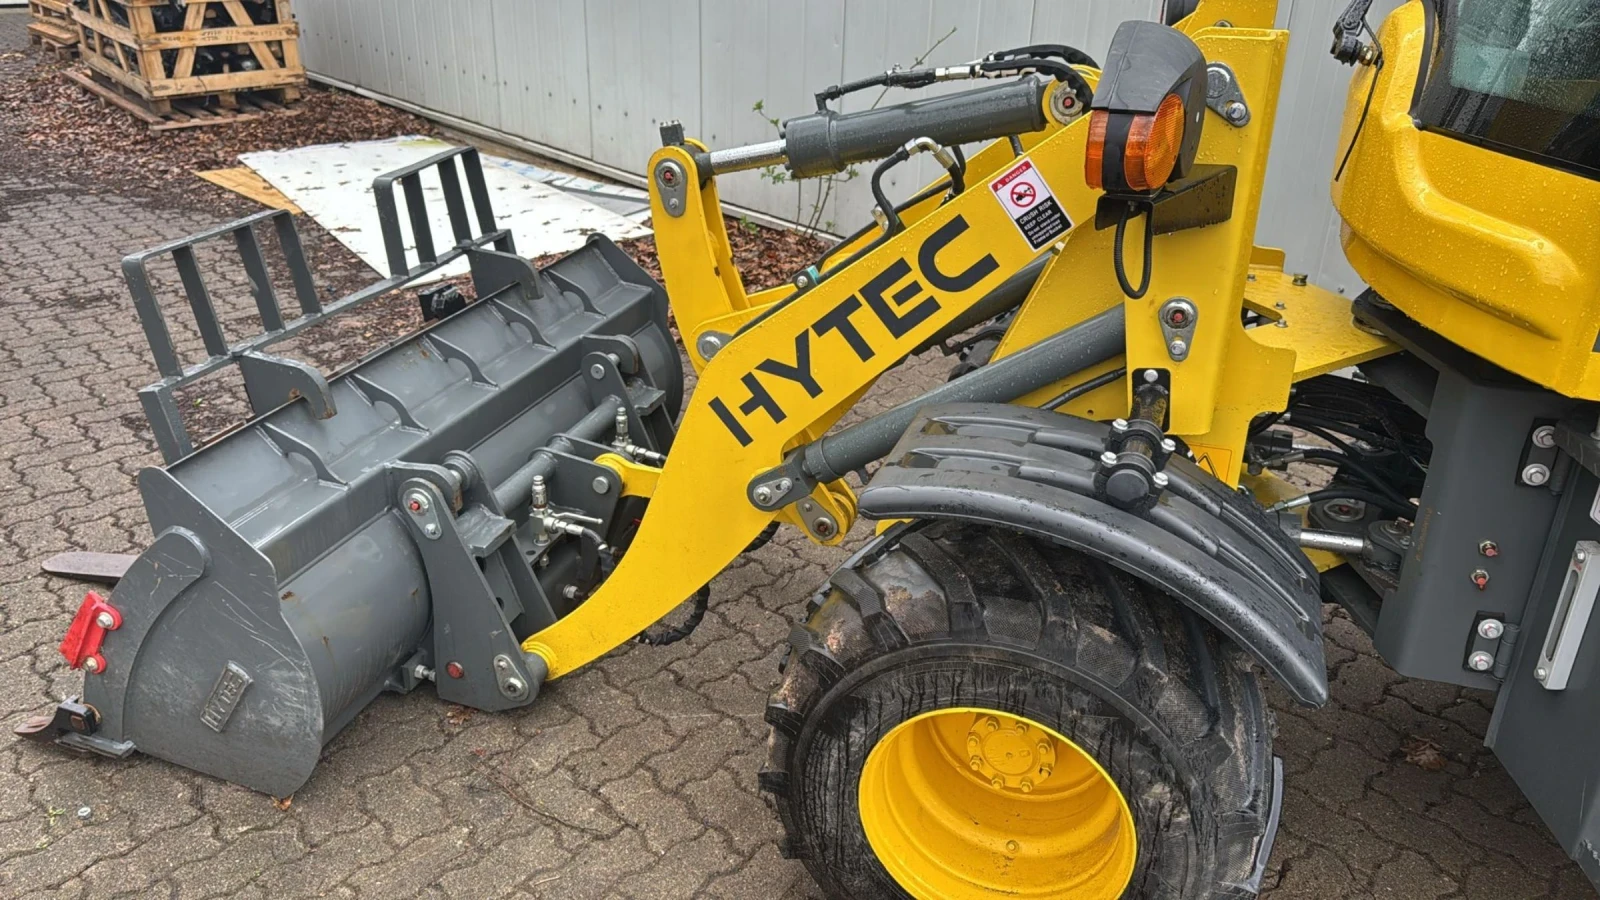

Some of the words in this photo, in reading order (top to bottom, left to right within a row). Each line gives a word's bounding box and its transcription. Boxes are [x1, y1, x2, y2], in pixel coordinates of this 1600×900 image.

[1005, 165, 1027, 183] DANGER
[1019, 209, 1039, 224] CRUSH
[1038, 200, 1053, 211] RISK
[1024, 219, 1037, 230] KEEP
[1036, 209, 1052, 222] CLEAR
[1040, 219, 1050, 228] stand
[1050, 212, 1061, 221] under
[708, 213, 1000, 448] HYTEC
